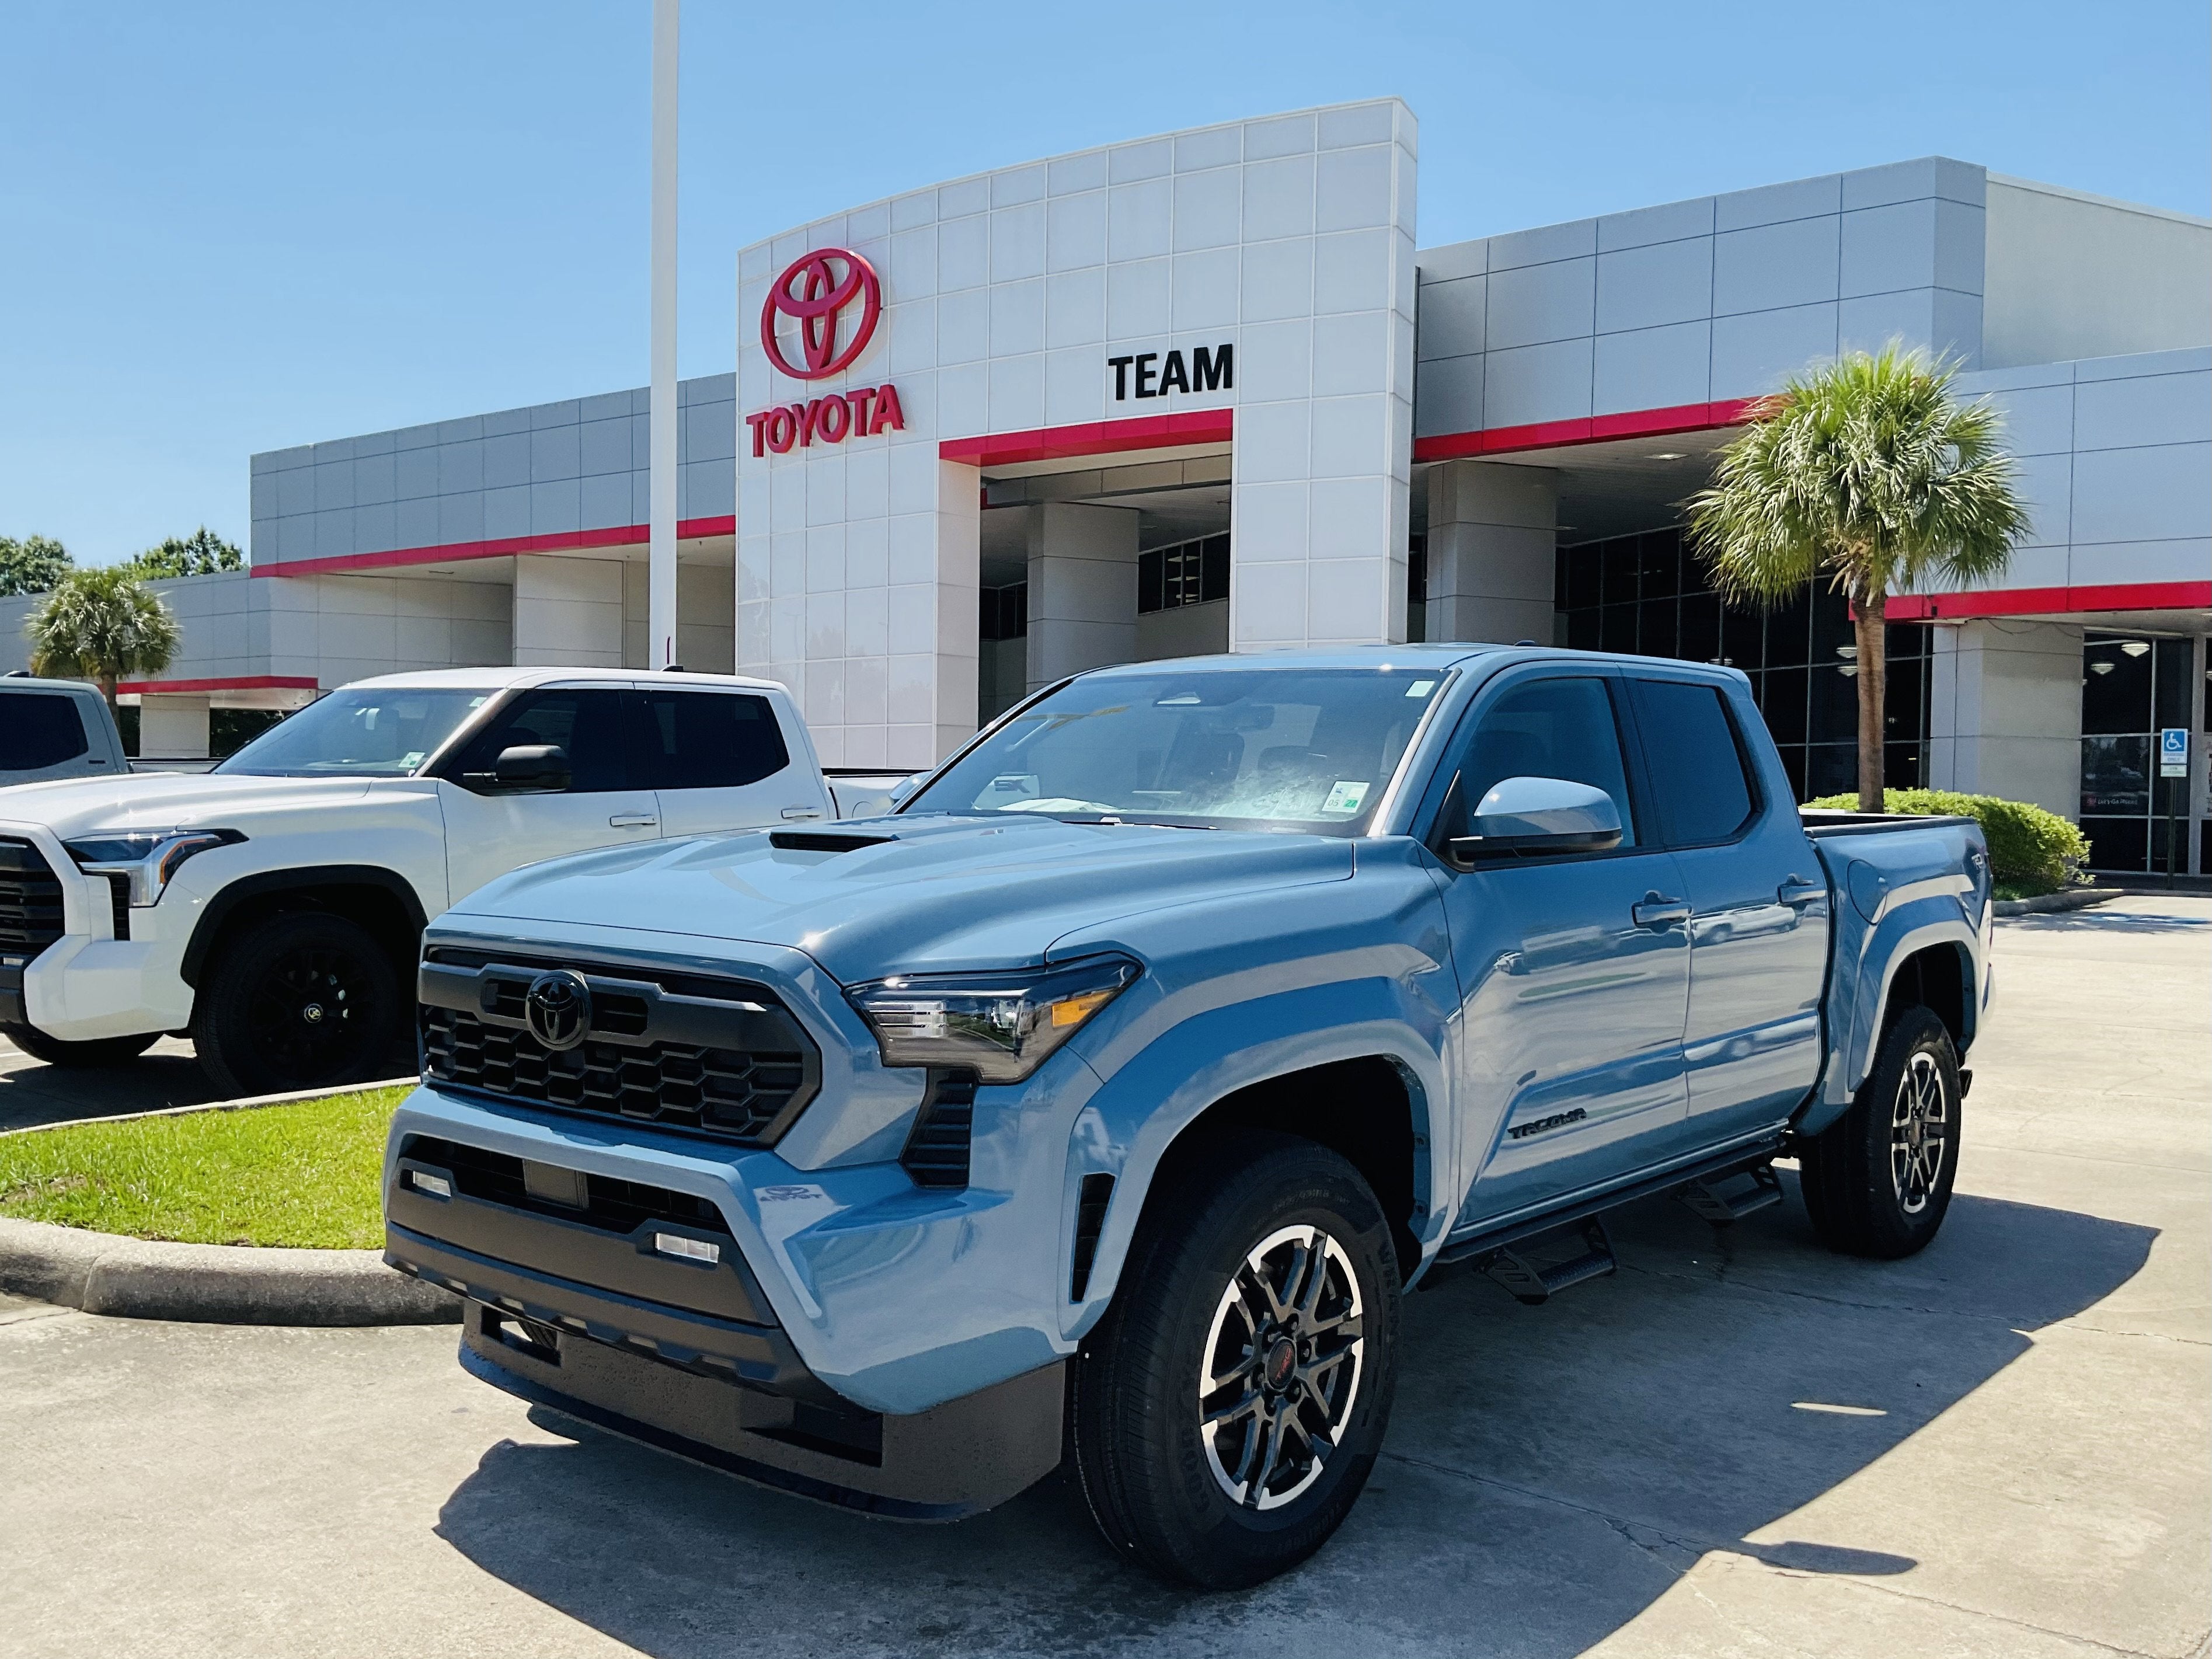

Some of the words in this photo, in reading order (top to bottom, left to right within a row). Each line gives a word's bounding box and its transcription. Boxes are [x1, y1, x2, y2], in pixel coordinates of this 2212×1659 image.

[1108, 344, 1234, 401] TEAM
[746, 384, 905, 458] TOYOTA
[1345, 799, 1358, 807] 27
